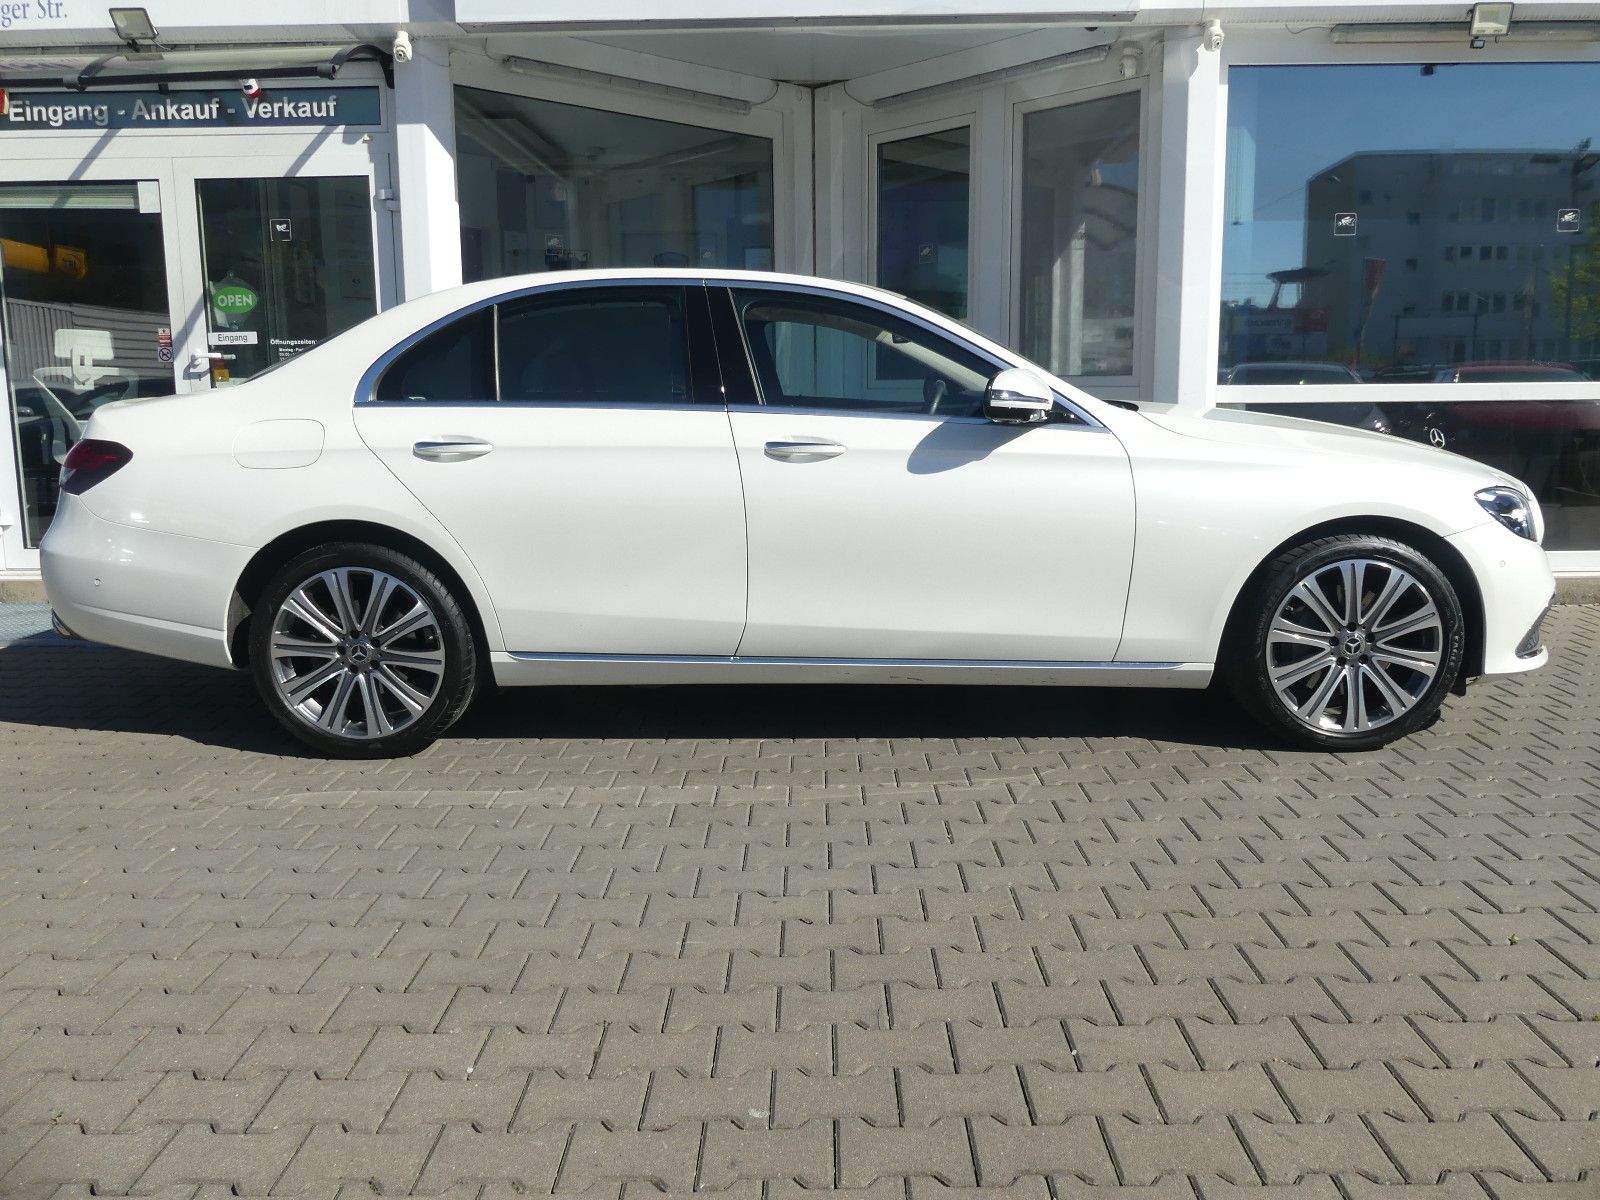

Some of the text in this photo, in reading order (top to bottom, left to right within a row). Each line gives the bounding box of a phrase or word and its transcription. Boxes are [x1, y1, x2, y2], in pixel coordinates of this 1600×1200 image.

[37, 0, 68, 19] Str.
[8, 100, 109, 127] Eingang
[131, 97, 220, 120] Ankauf
[241, 95, 337, 119] Verkauf
[217, 294, 253, 307] OPEN
[217, 333, 248, 344] Eingang
